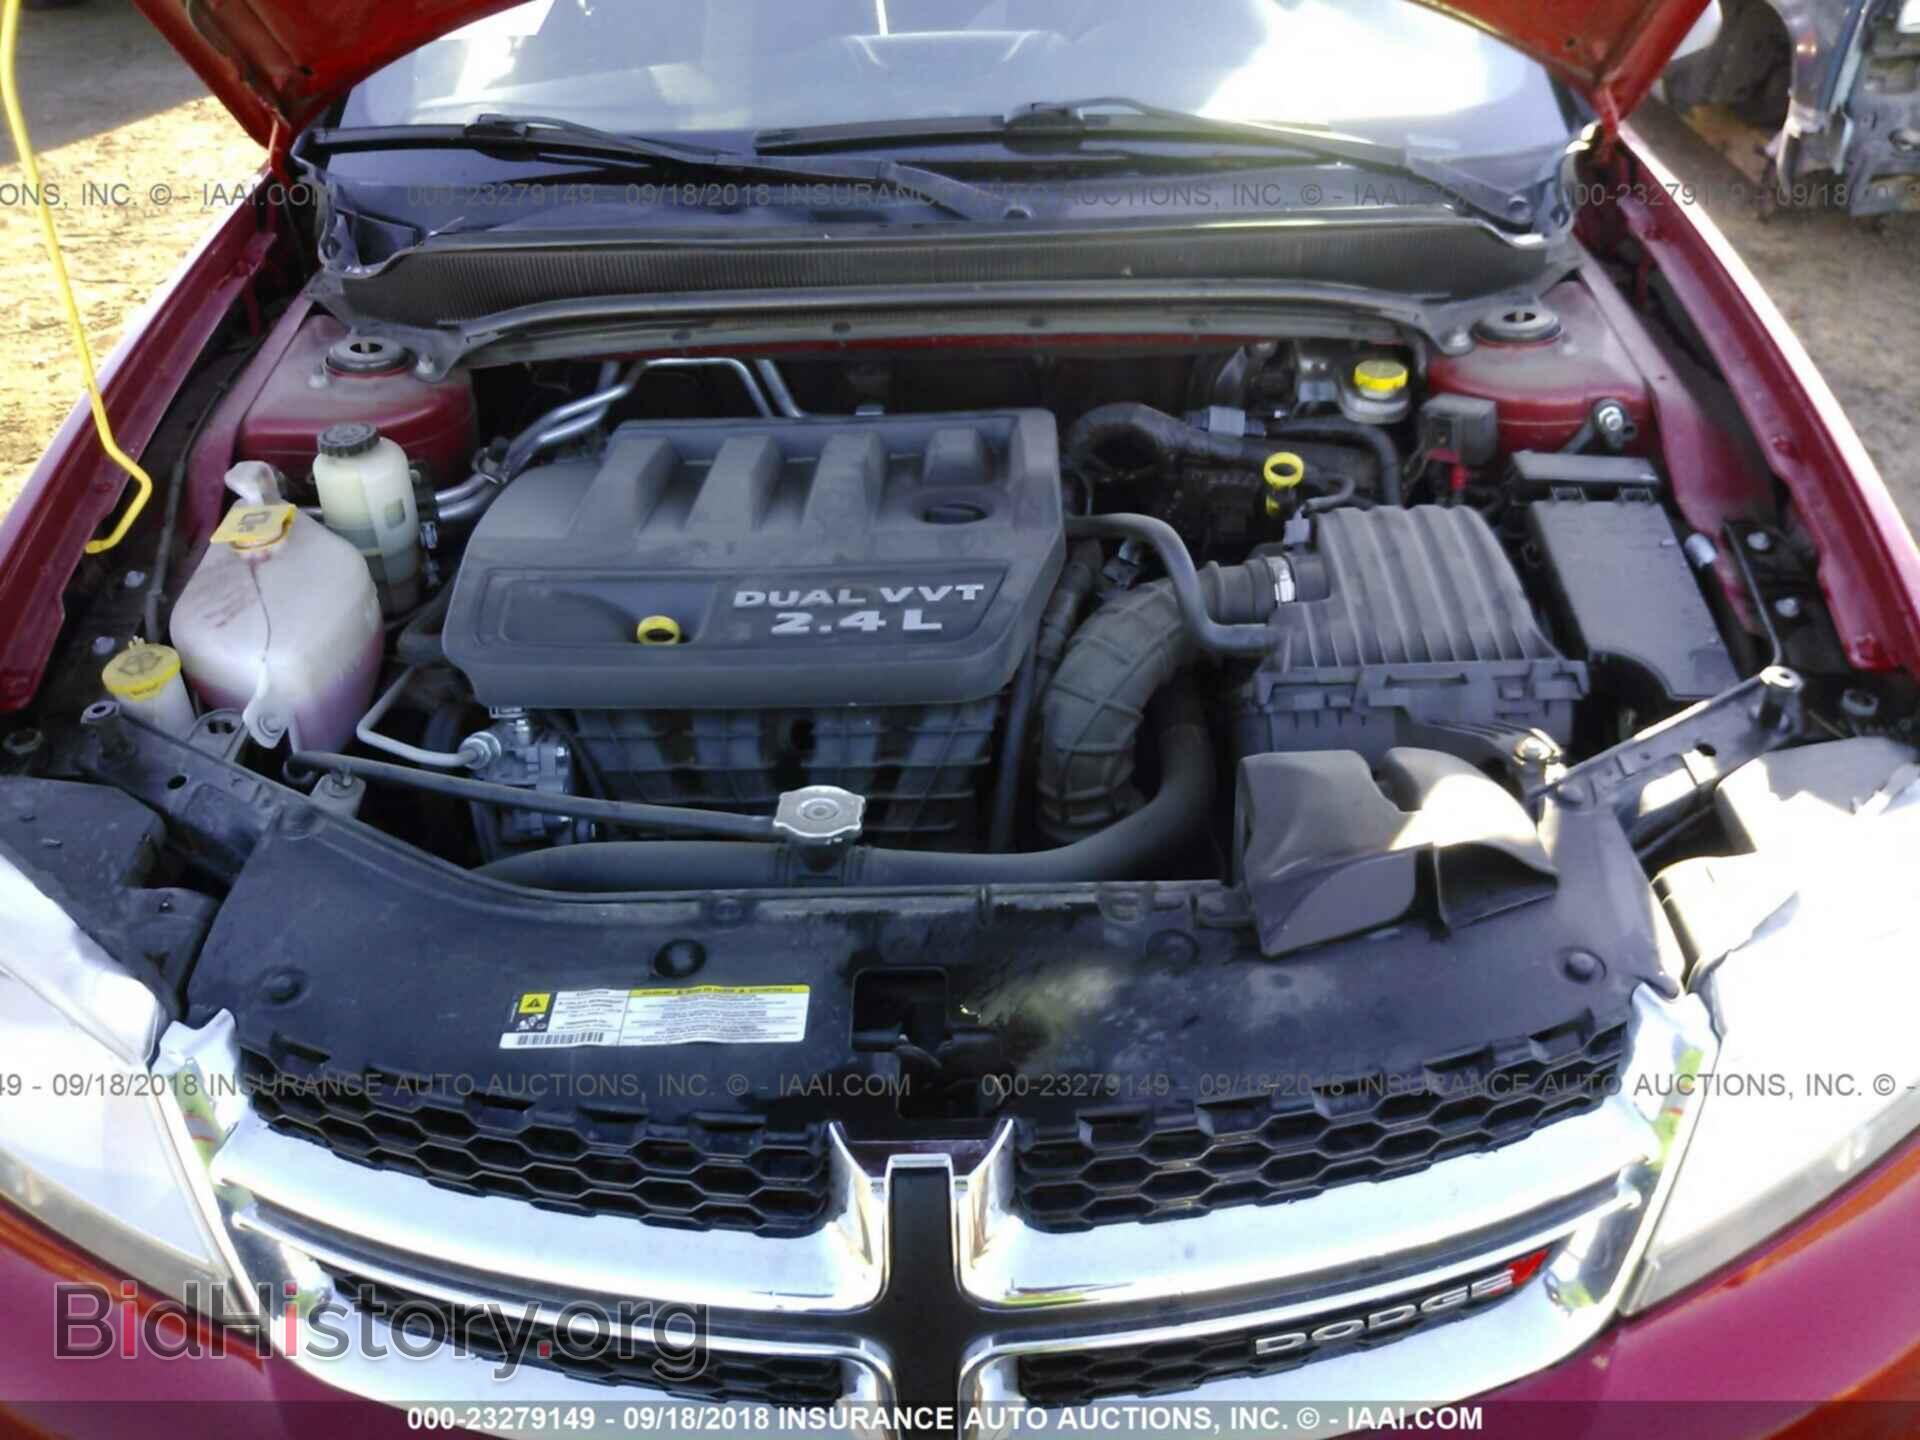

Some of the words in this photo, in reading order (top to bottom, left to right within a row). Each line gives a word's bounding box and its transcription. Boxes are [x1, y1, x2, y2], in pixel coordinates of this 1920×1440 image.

[733, 589, 867, 608] DUAL
[879, 584, 985, 603] VVT
[1255, 1269, 1513, 1355] DODGE
